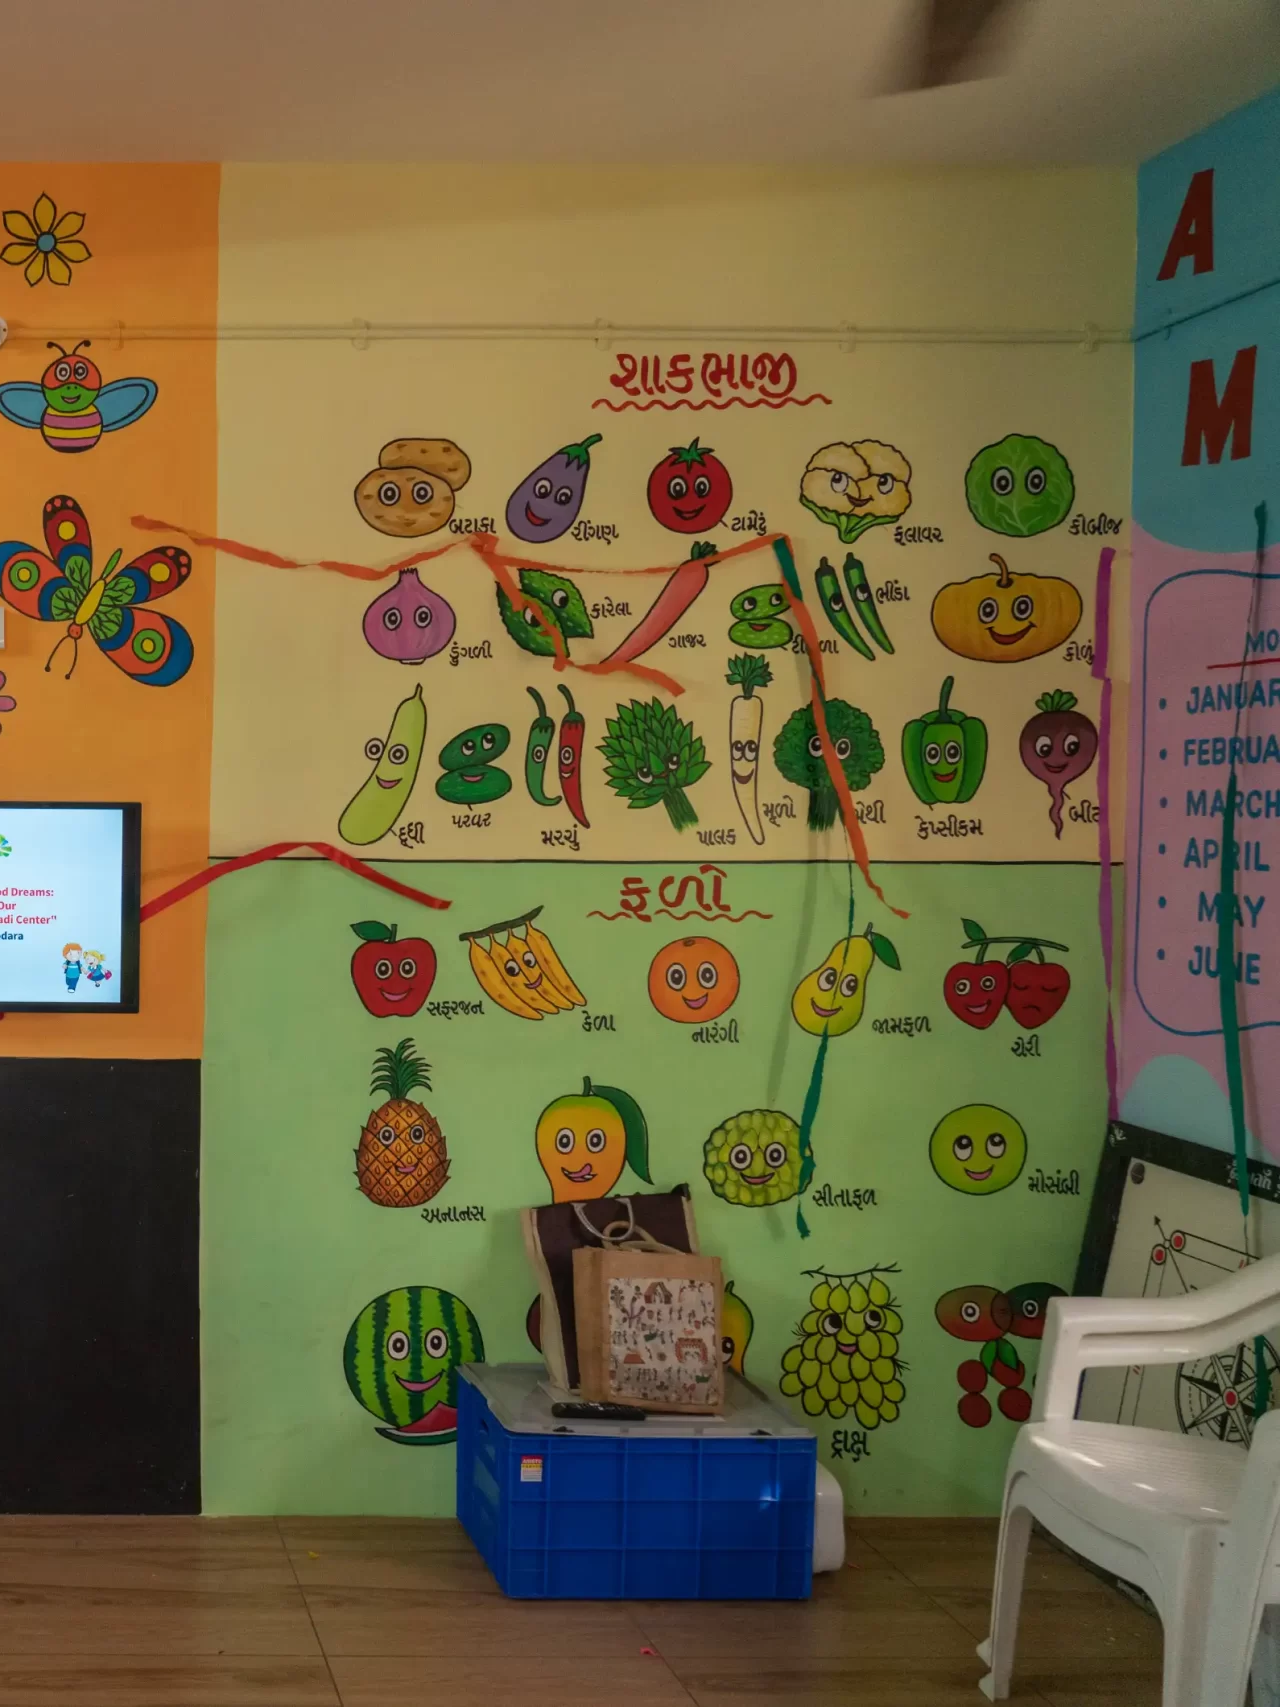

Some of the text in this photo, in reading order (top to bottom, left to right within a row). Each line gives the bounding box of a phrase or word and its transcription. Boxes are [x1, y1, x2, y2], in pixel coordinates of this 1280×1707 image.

[1156, 168, 1215, 281] A
[610, 353, 797, 399] શાકભાજી
[1180, 344, 1258, 467] M
[449, 516, 497, 535] બટાકા
[571, 520, 619, 545] રીંગણ
[731, 510, 767, 536] ટામેટું
[1068, 512, 1123, 536] કોબીજ
[894, 525, 944, 546] ફલાવર
[875, 580, 910, 602] ભીંડા
[590, 597, 632, 619] કારેલા
[668, 633, 707, 649] ગાજર
[449, 640, 493, 667] ડુંગળી
[452, 812, 492, 828] પરવર
[763, 794, 797, 827] મૂળો
[398, 821, 425, 849] દૂધી
[541, 823, 581, 851] મરચું
[697, 828, 737, 847] પાલક
[914, 814, 984, 841] કેપ્સીકમ
[11, 887, 54, 897] Dreams:
[620, 864, 732, 922] ફળો
[16, 915, 57, 925] Center"
[426, 1000, 485, 1020] સફરજન
[581, 1010, 616, 1033] કેળા
[692, 1018, 740, 1044] નારંગી
[872, 1016, 932, 1036] જામફળ
[1010, 1034, 1042, 1058] ચેરી
[1028, 1168, 1081, 1197] મોસંબી
[813, 1182, 878, 1209] સીતાફળ
[420, 1204, 487, 1224] અનાનસ
[830, 1429, 871, 1462] દ્રાક્ષ
